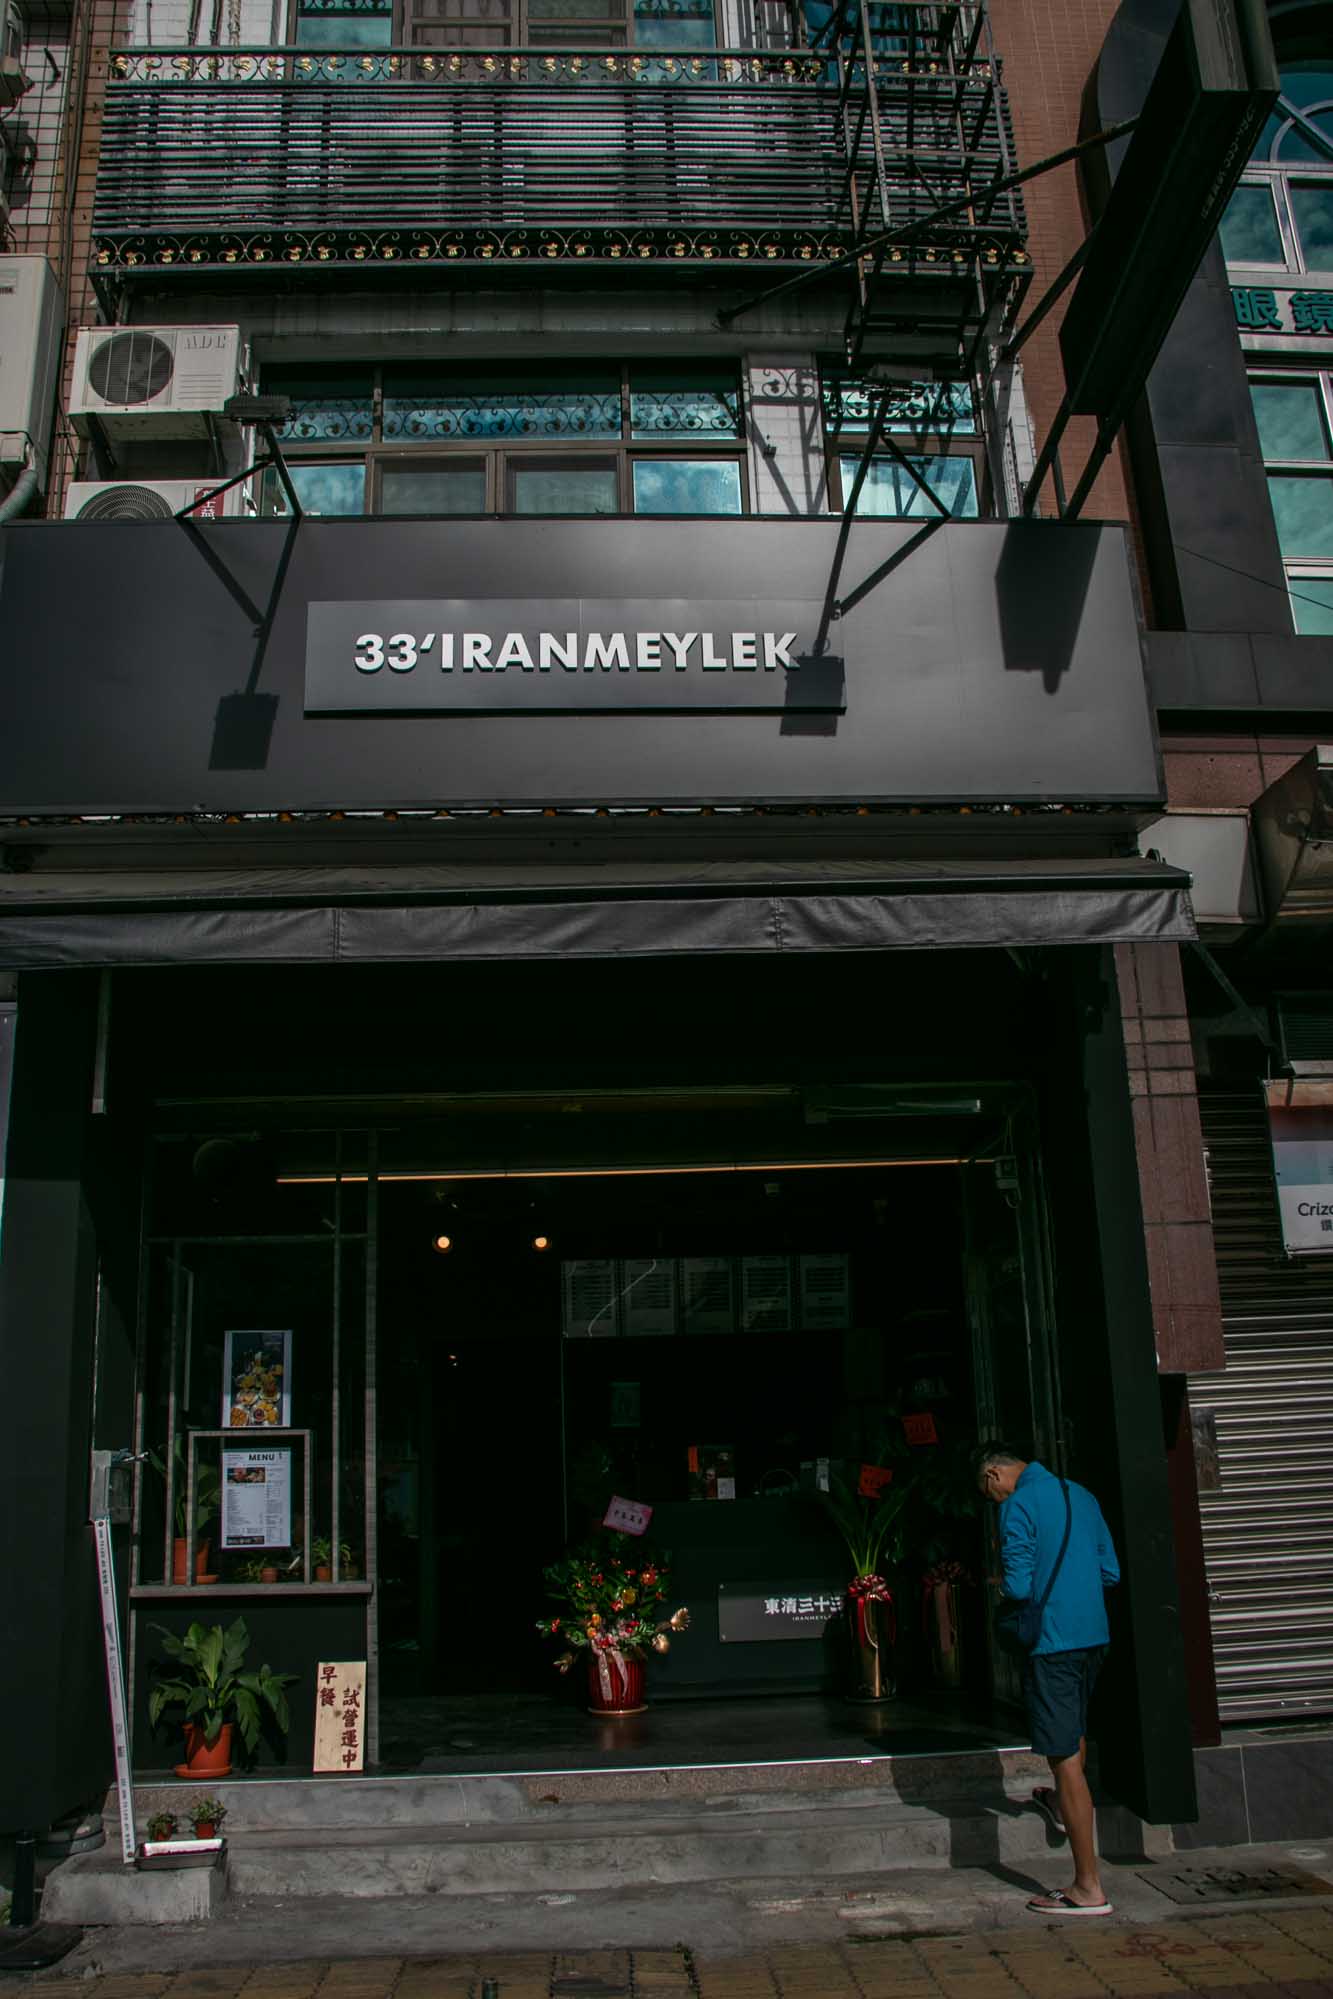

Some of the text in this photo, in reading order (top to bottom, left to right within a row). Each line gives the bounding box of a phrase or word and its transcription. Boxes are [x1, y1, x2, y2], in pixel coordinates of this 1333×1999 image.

[248, 1453, 275, 1461] MENU
[340, 1686, 361, 1769] 試營運中
